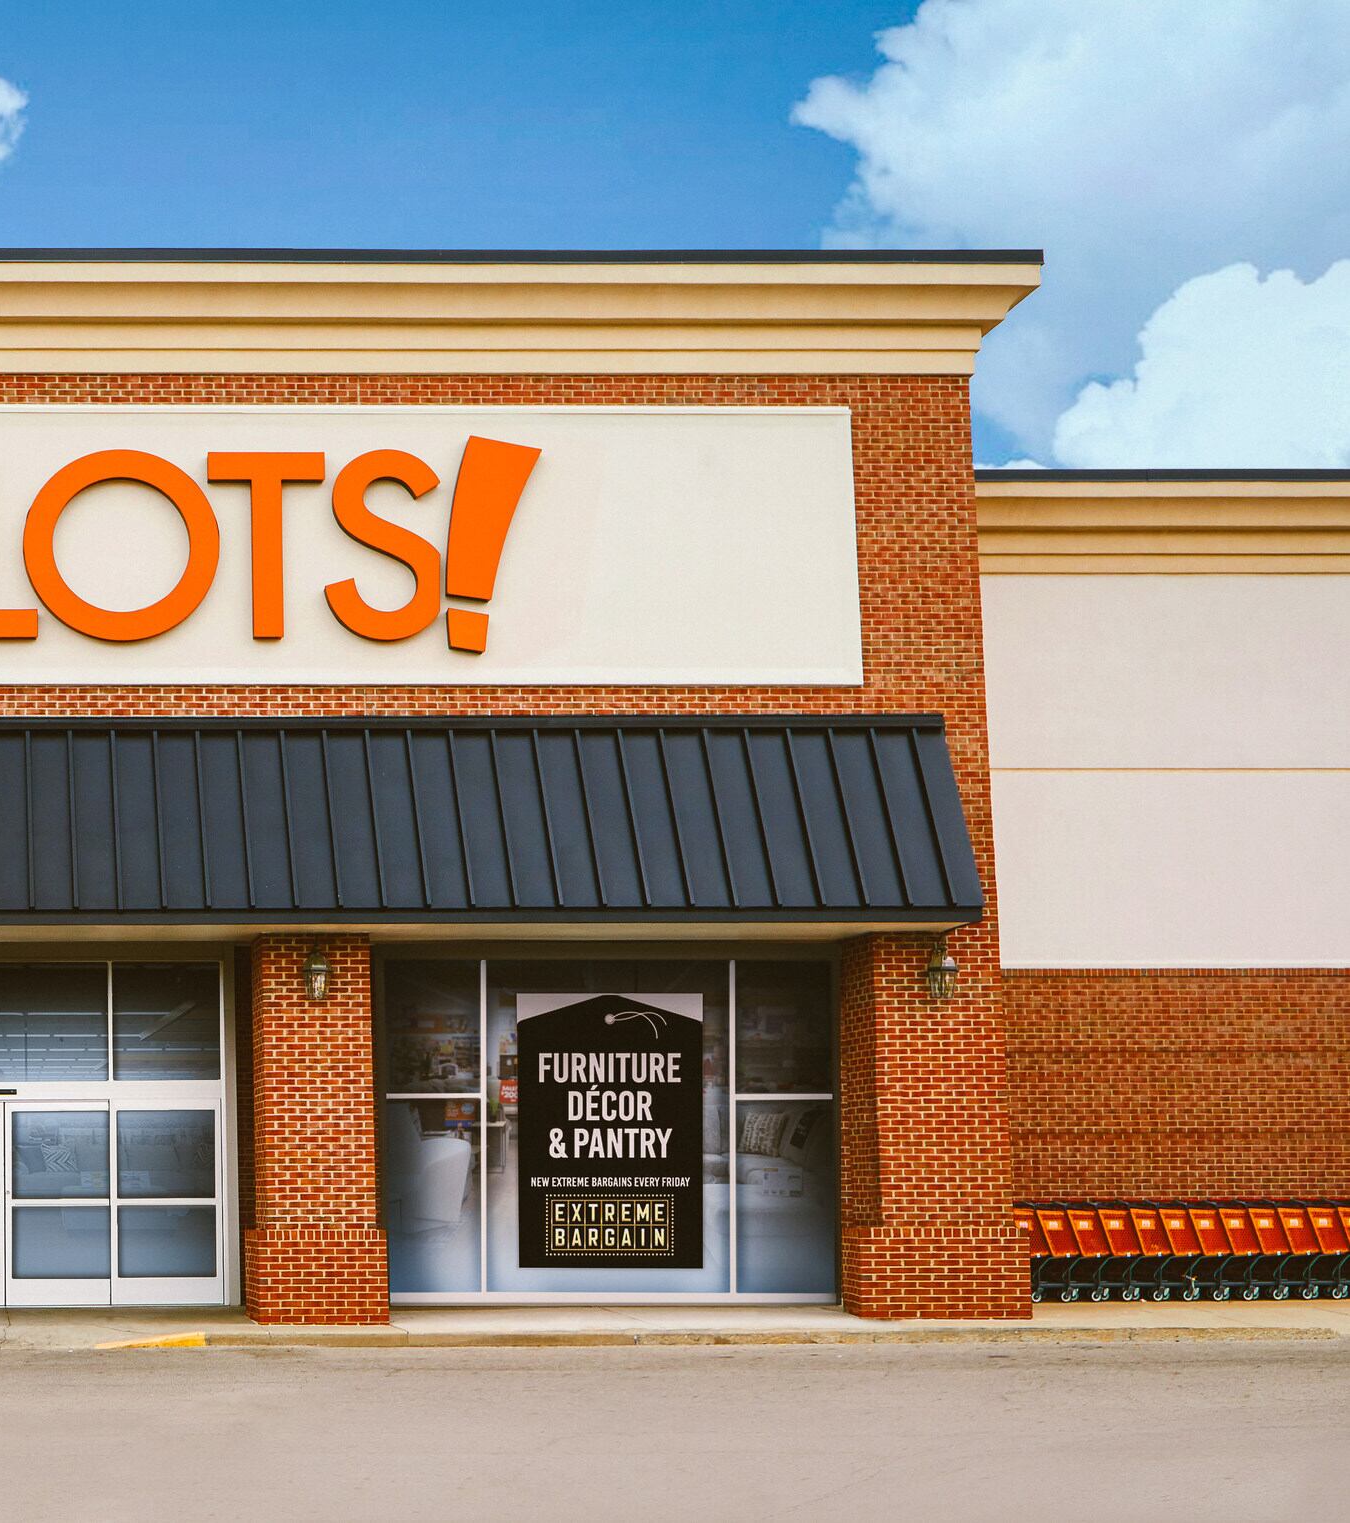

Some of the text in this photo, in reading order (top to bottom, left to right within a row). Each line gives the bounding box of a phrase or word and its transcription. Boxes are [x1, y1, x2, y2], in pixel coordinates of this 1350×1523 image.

[538, 1052, 682, 1083] FURNITURE
[567, 1084, 653, 1122] DÉCOR
[548, 1127, 673, 1159] & PANTRY
[530, 1176, 691, 1188] NEW EXTREME BARGAINS EVERY FRIDAY
[554, 1202, 665, 1223] EXTREME
[554, 1227, 665, 1248] BARGAIN
